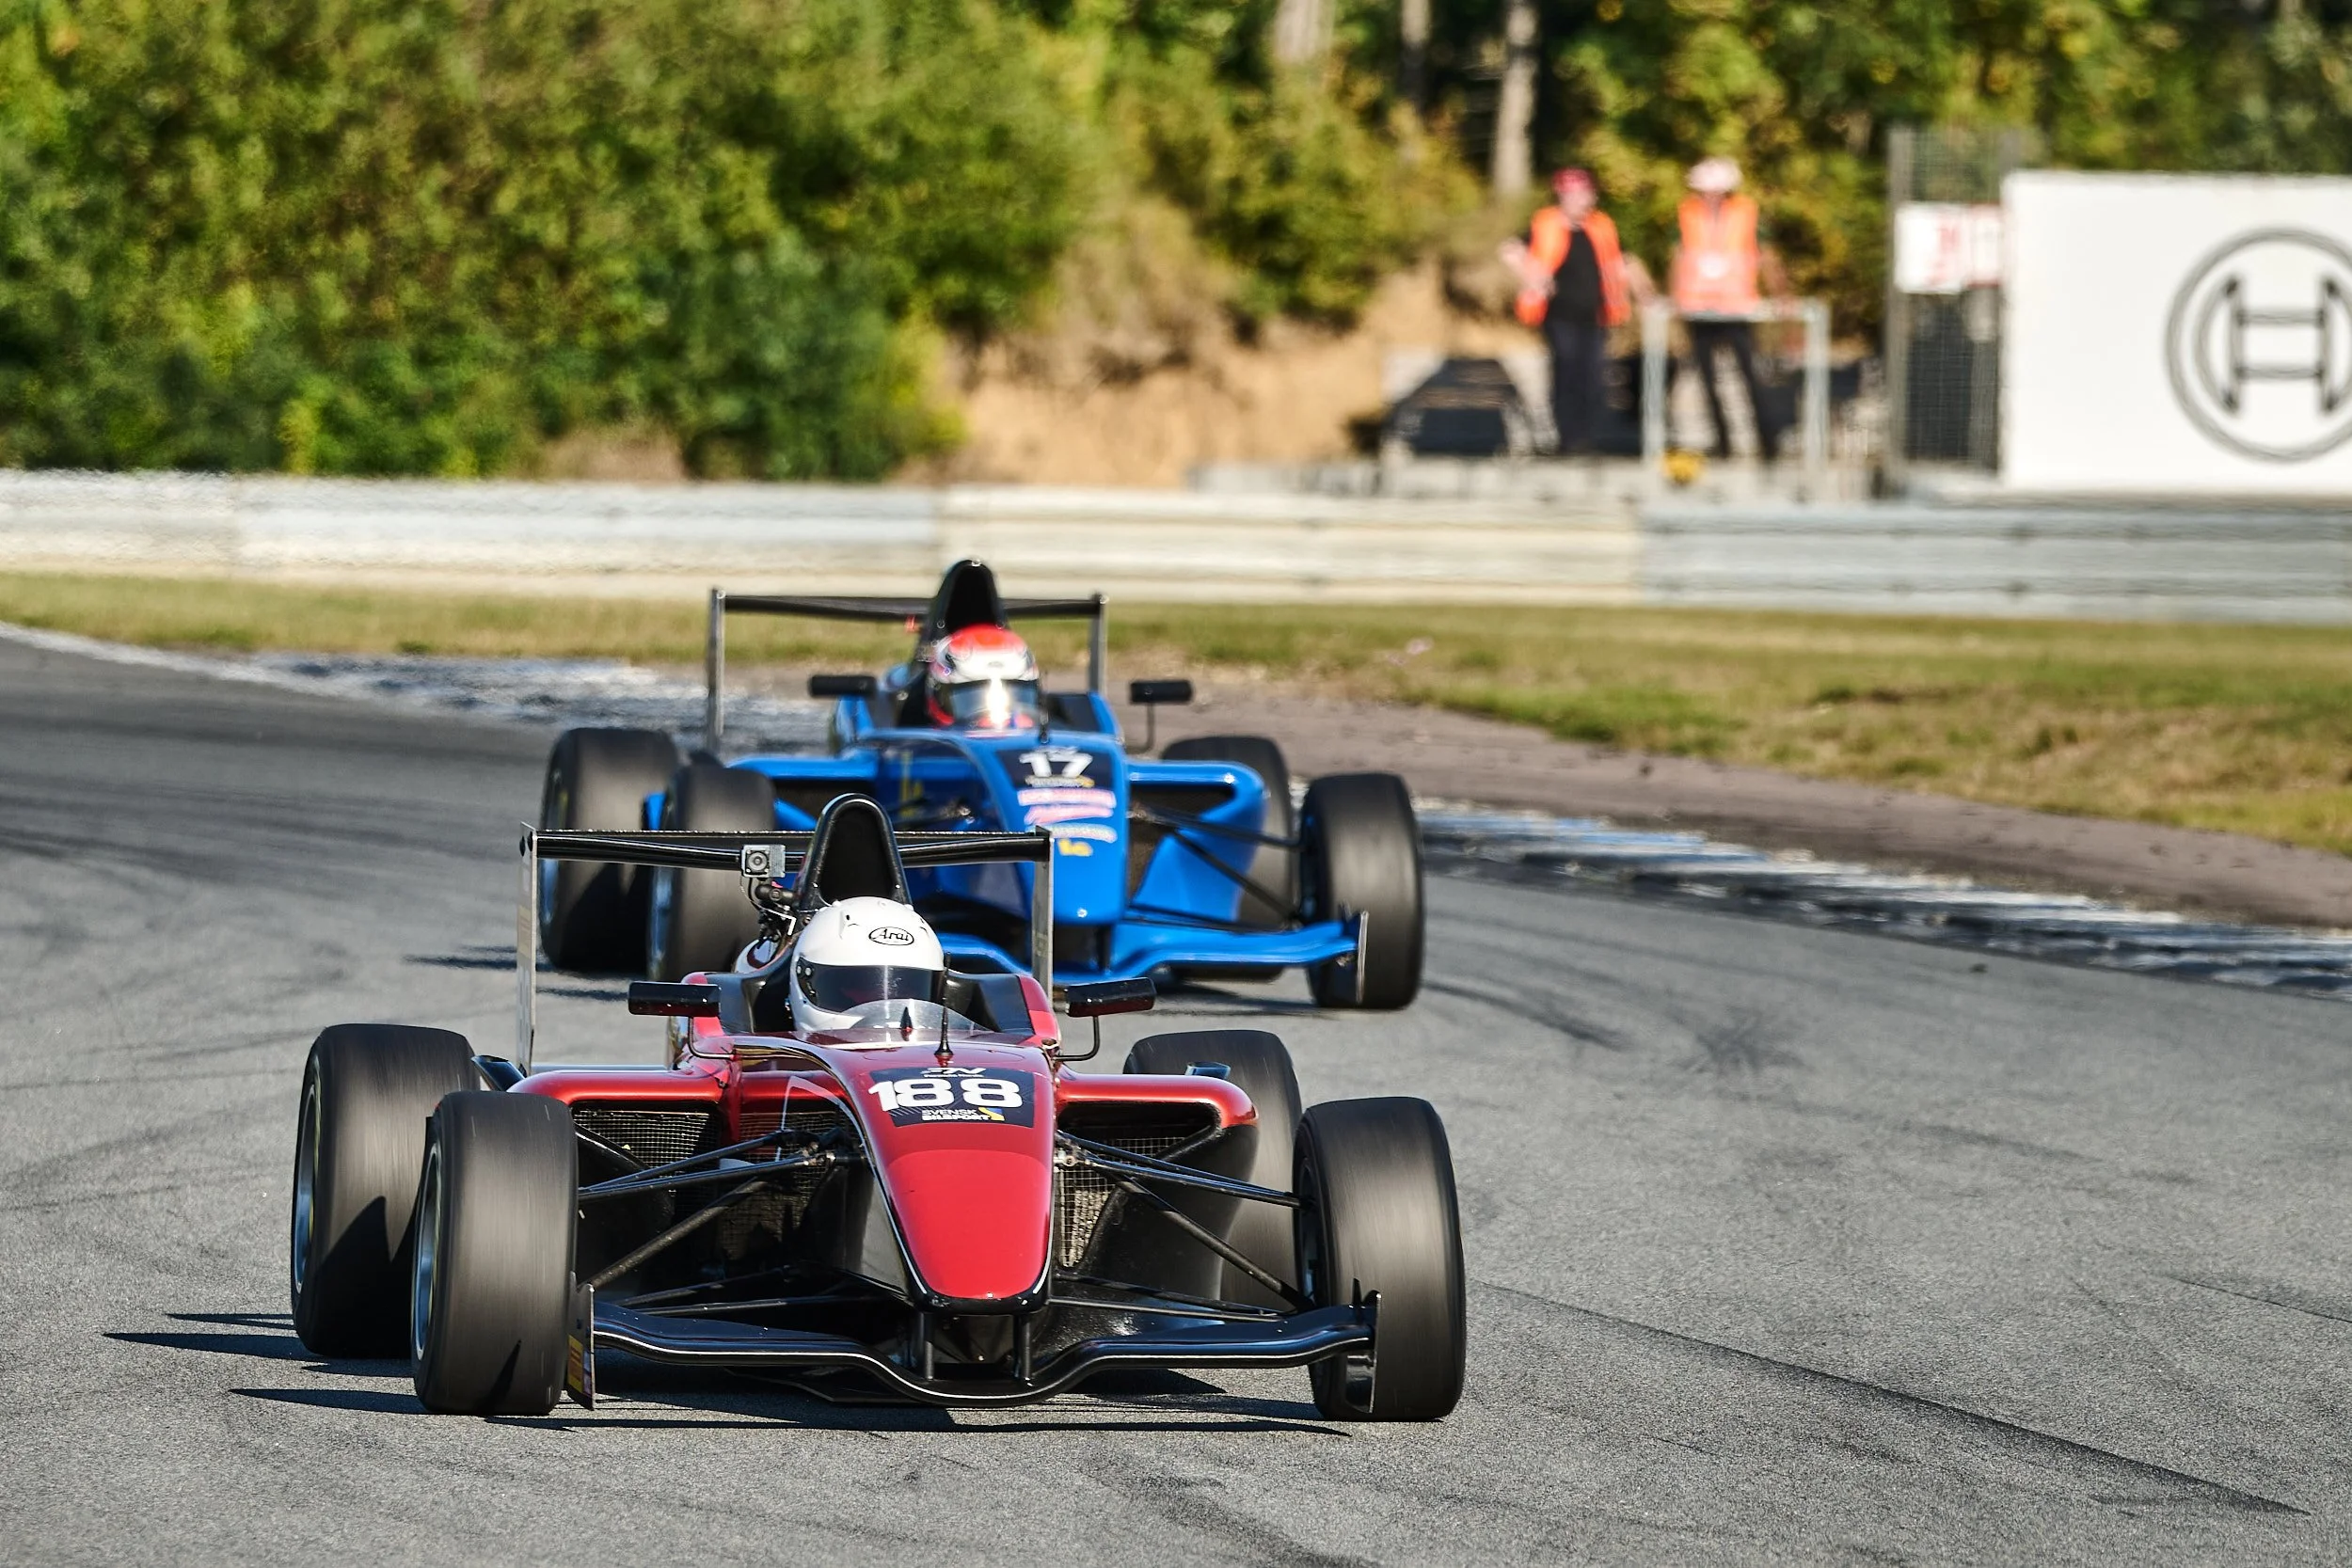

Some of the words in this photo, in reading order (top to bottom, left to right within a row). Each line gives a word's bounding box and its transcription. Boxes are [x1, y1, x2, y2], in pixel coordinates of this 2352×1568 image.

[1019, 752, 1093, 778] 17
[876, 928, 909, 942] Arai
[868, 1078, 1024, 1112] 188
